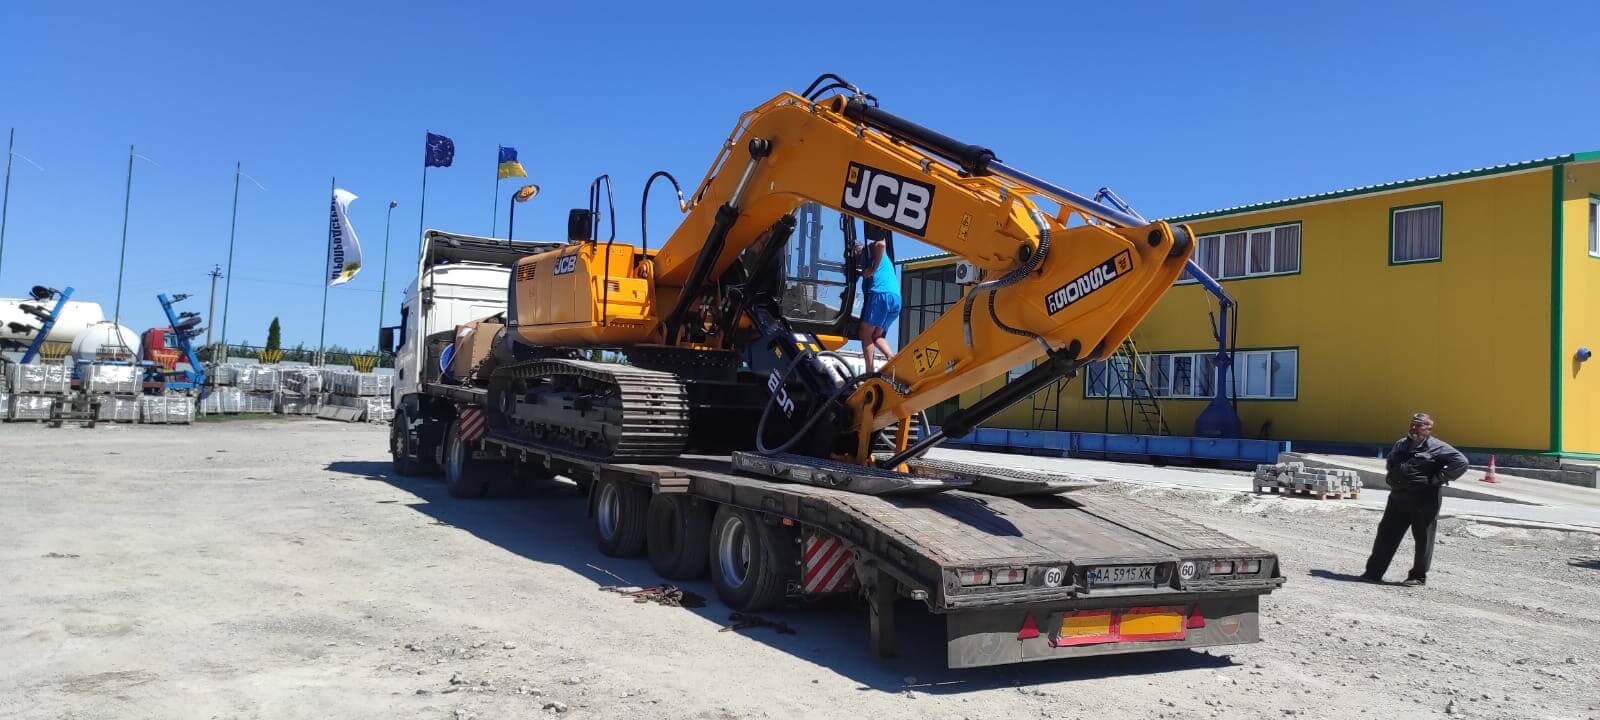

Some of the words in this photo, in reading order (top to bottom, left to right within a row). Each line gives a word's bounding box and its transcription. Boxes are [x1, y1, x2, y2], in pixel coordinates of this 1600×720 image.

[845, 170, 930, 230] JCB
[554, 256, 577, 274] JCB
[767, 372, 795, 413] JCB
[1047, 572, 1061, 583] 60
[1095, 568, 1110, 581] AA
[1113, 567, 1136, 581] 5915
[1138, 567, 1153, 580] XK
[1181, 565, 1194, 576] 60
